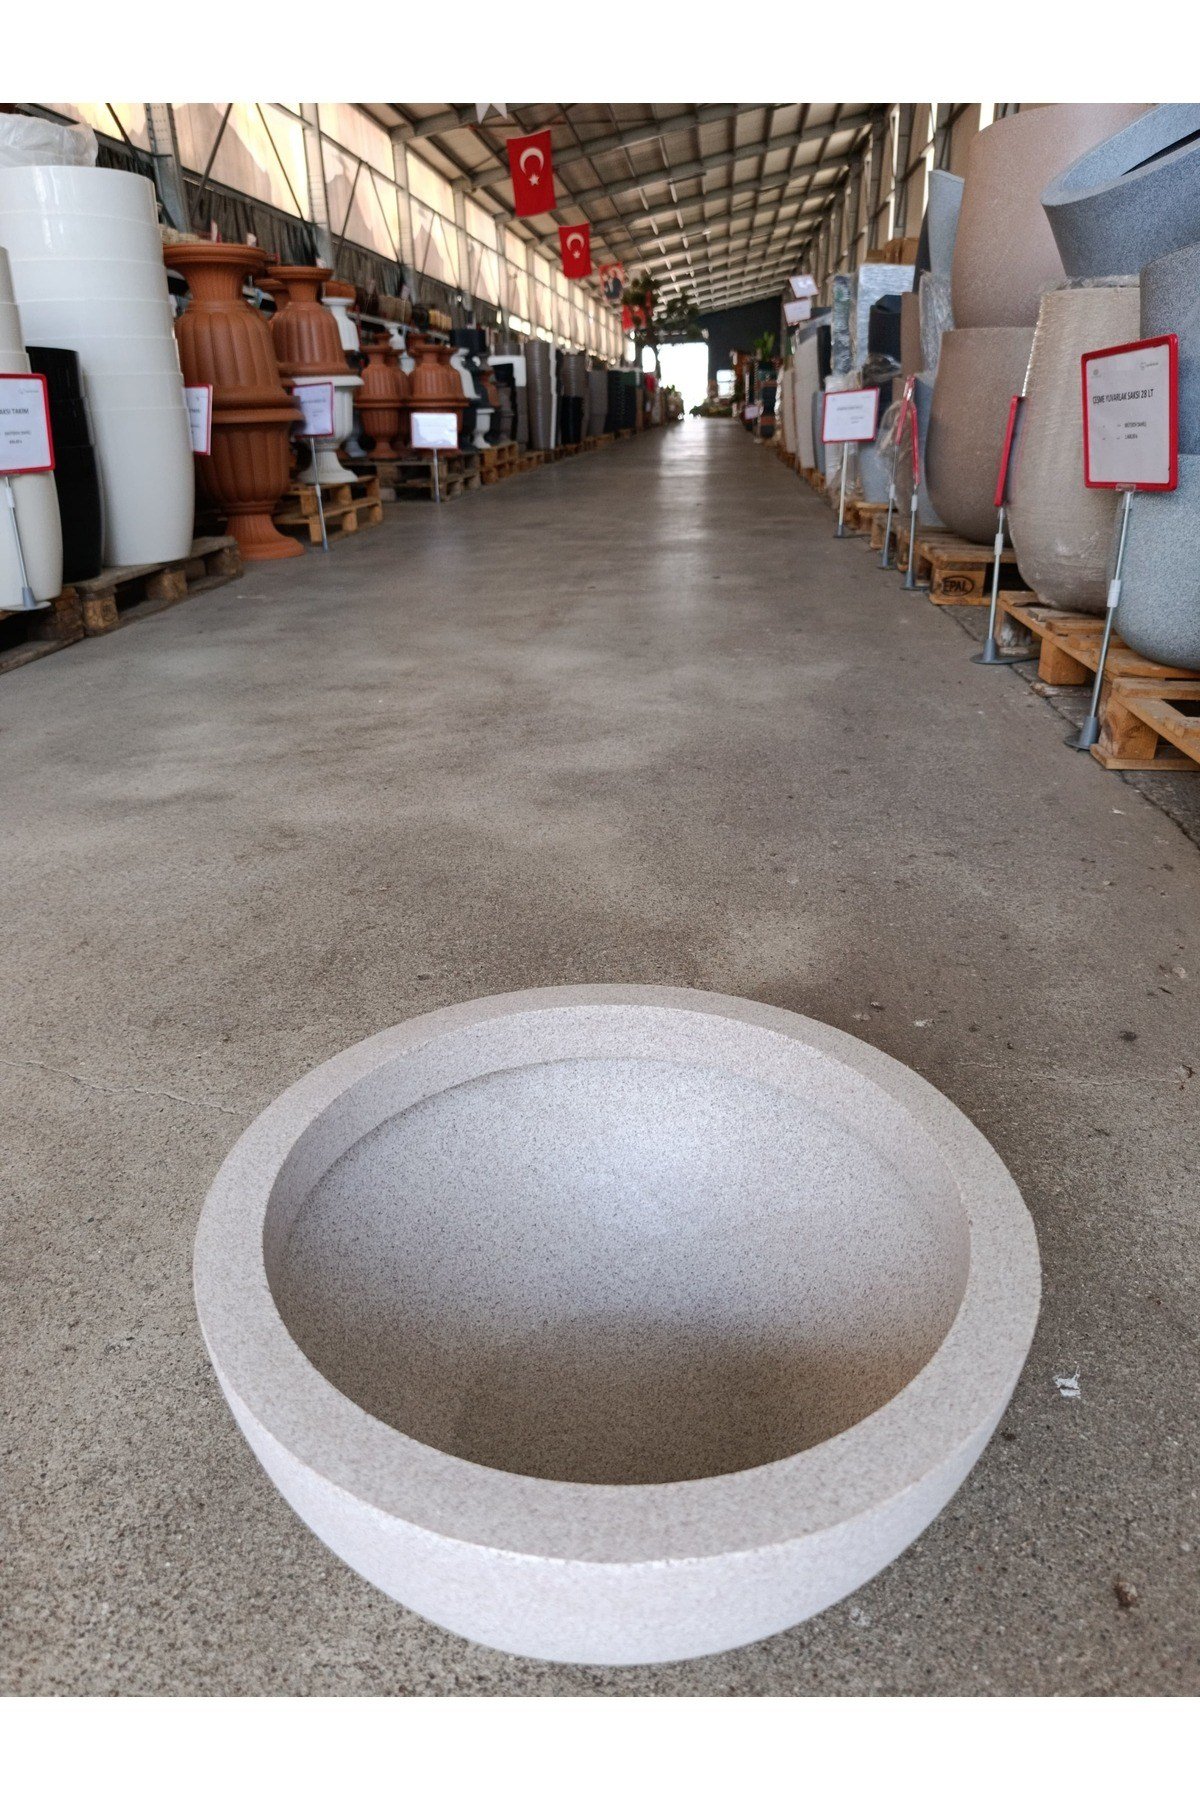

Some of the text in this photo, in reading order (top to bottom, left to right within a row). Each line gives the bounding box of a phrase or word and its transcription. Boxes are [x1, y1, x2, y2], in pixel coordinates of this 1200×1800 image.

[1127, 390, 1140, 400] SAKSI
[1140, 389, 1148, 398] 28
[1148, 388, 1154, 397] LT
[943, 580, 967, 593] EPAL
